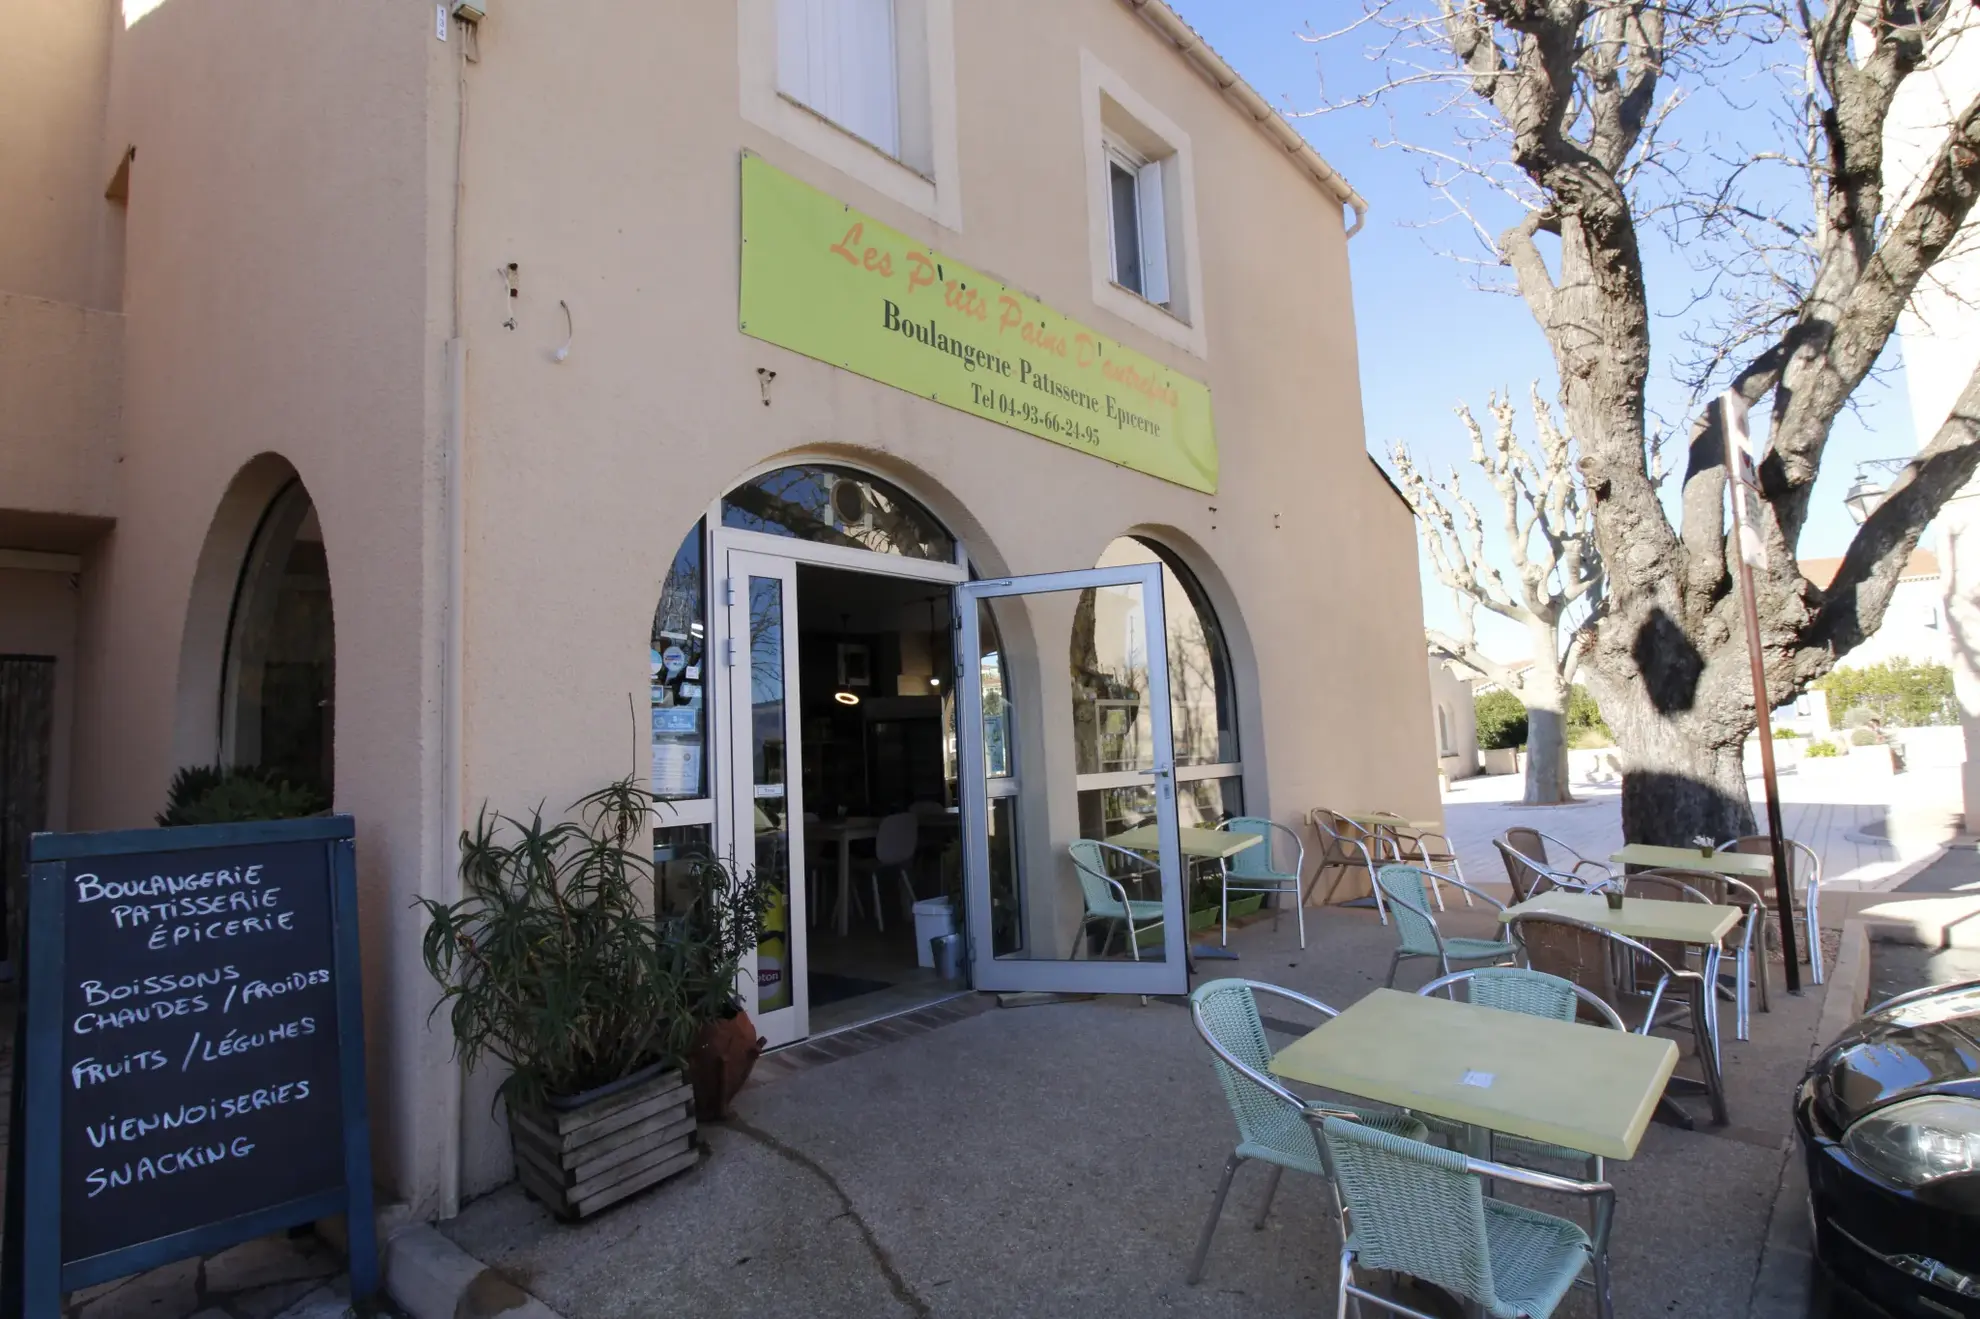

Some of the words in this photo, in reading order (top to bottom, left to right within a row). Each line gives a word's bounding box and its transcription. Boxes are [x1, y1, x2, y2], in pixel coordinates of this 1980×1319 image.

[830, 222, 894, 278] Les
[998, 295, 1066, 358] Pains
[882, 298, 1012, 378] Boulangerie
[1019, 357, 1100, 413] Patisserie
[1105, 394, 1161, 438] Epicerie
[971, 382, 994, 410] Tel
[999, 393, 1100, 447] 04-93-66-24-95
[73, 995, 209, 1035] CHAUDES
